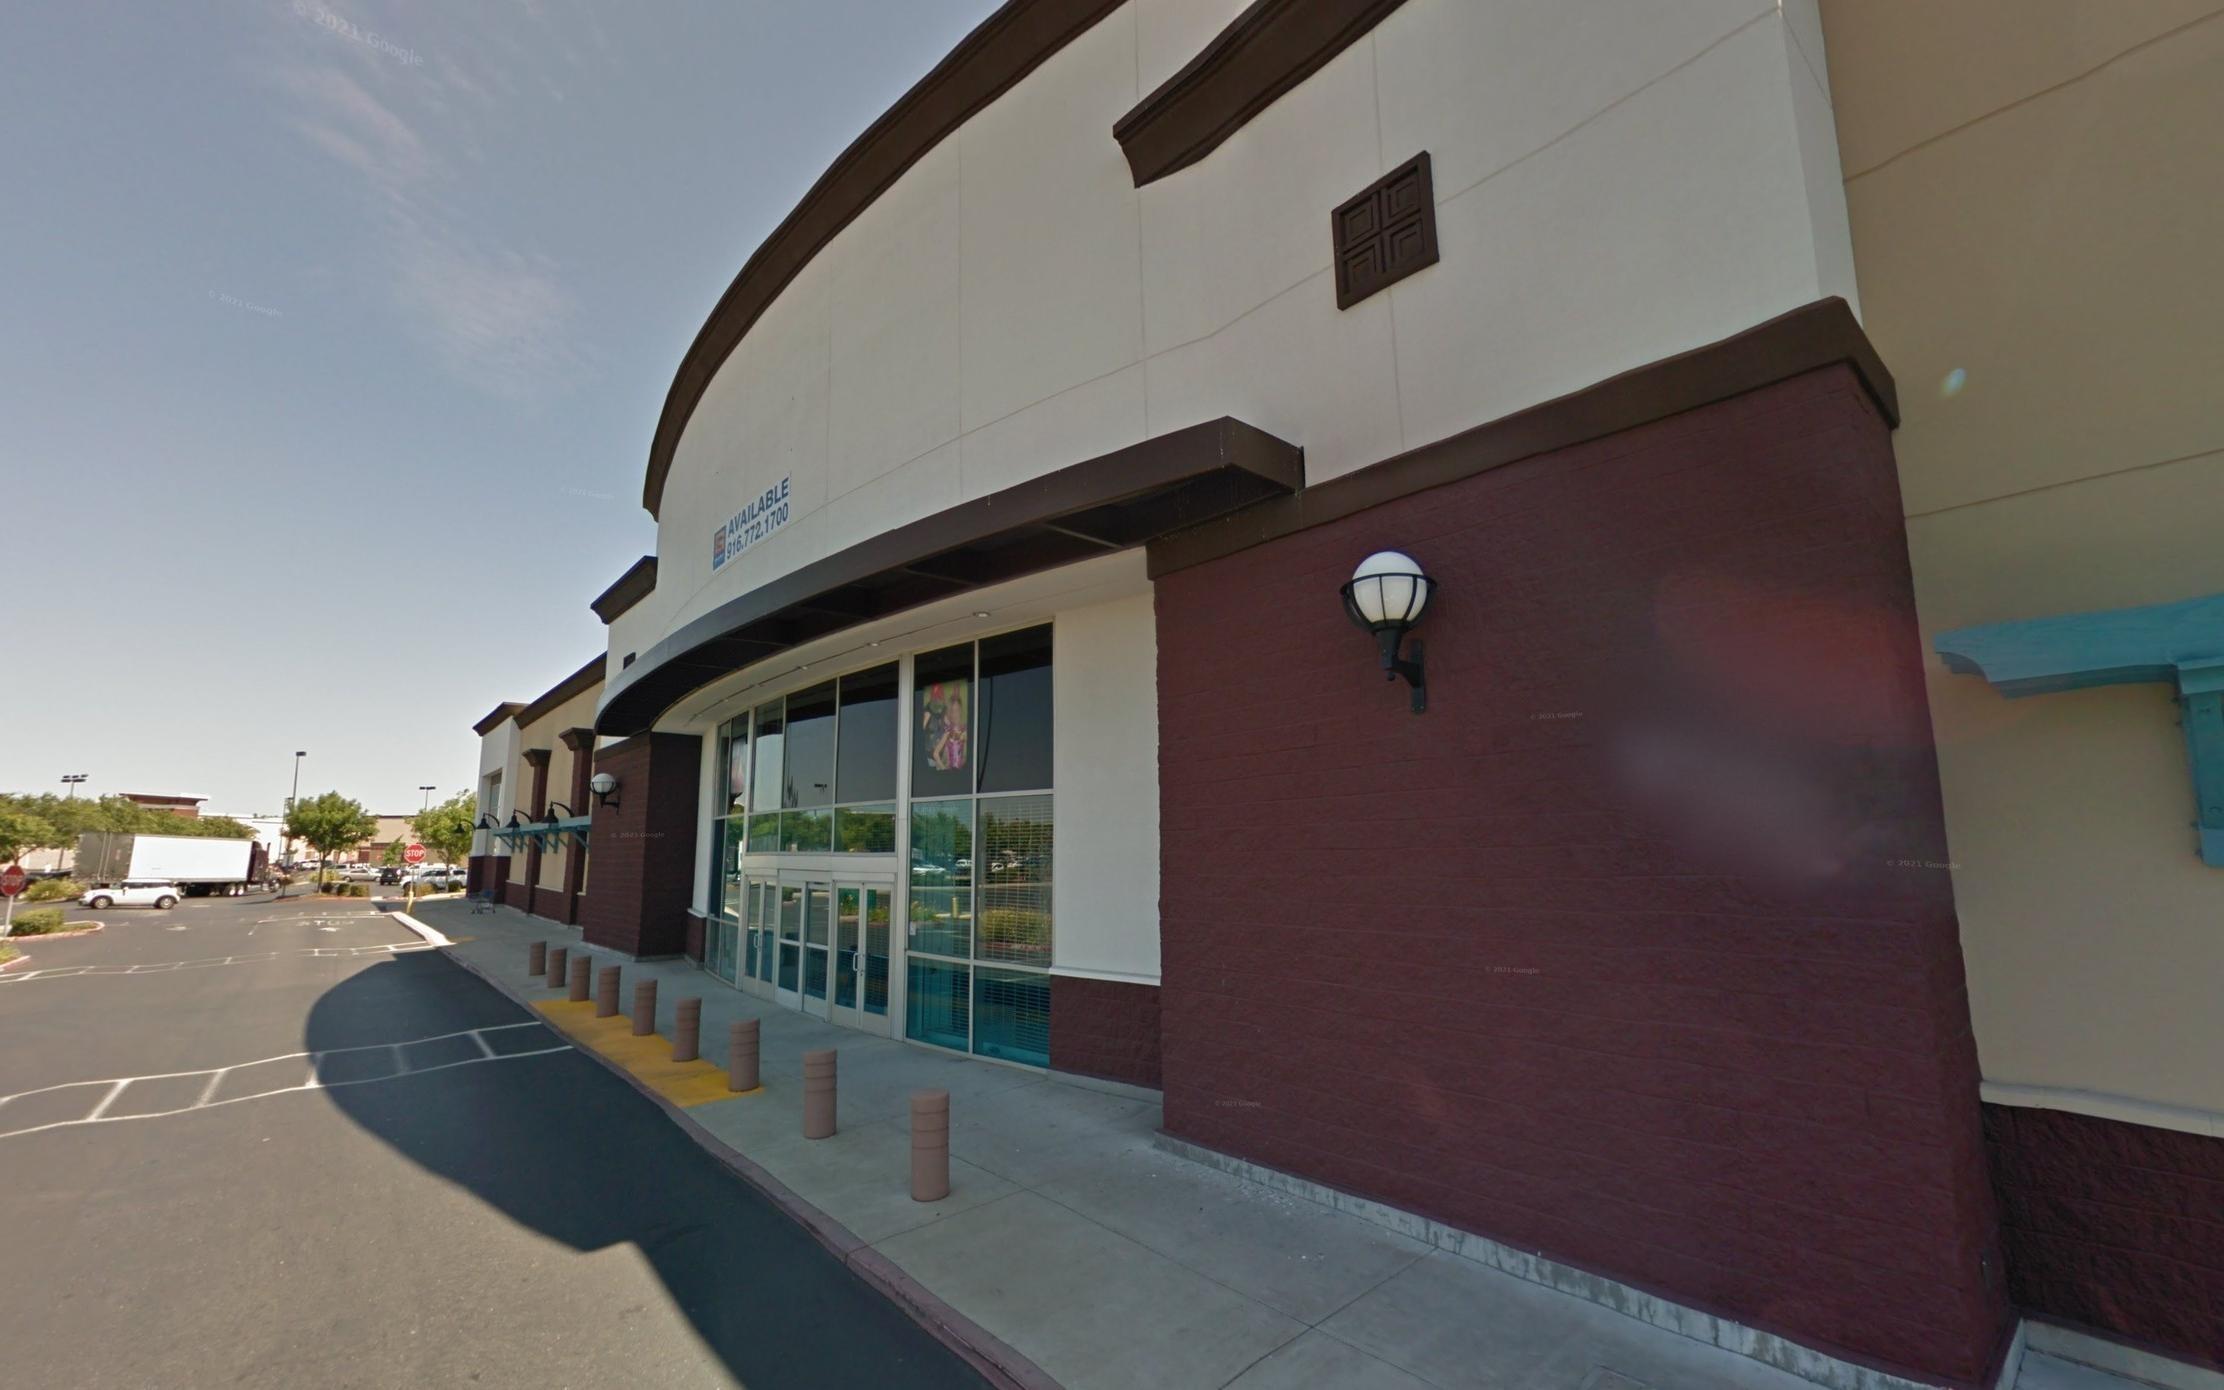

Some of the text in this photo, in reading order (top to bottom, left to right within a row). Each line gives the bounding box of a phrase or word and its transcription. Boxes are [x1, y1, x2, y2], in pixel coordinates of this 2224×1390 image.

[726, 502, 789, 560] 916.772.1700
[727, 477, 790, 537] AVAILABLE
[405, 849, 425, 857] STOP
